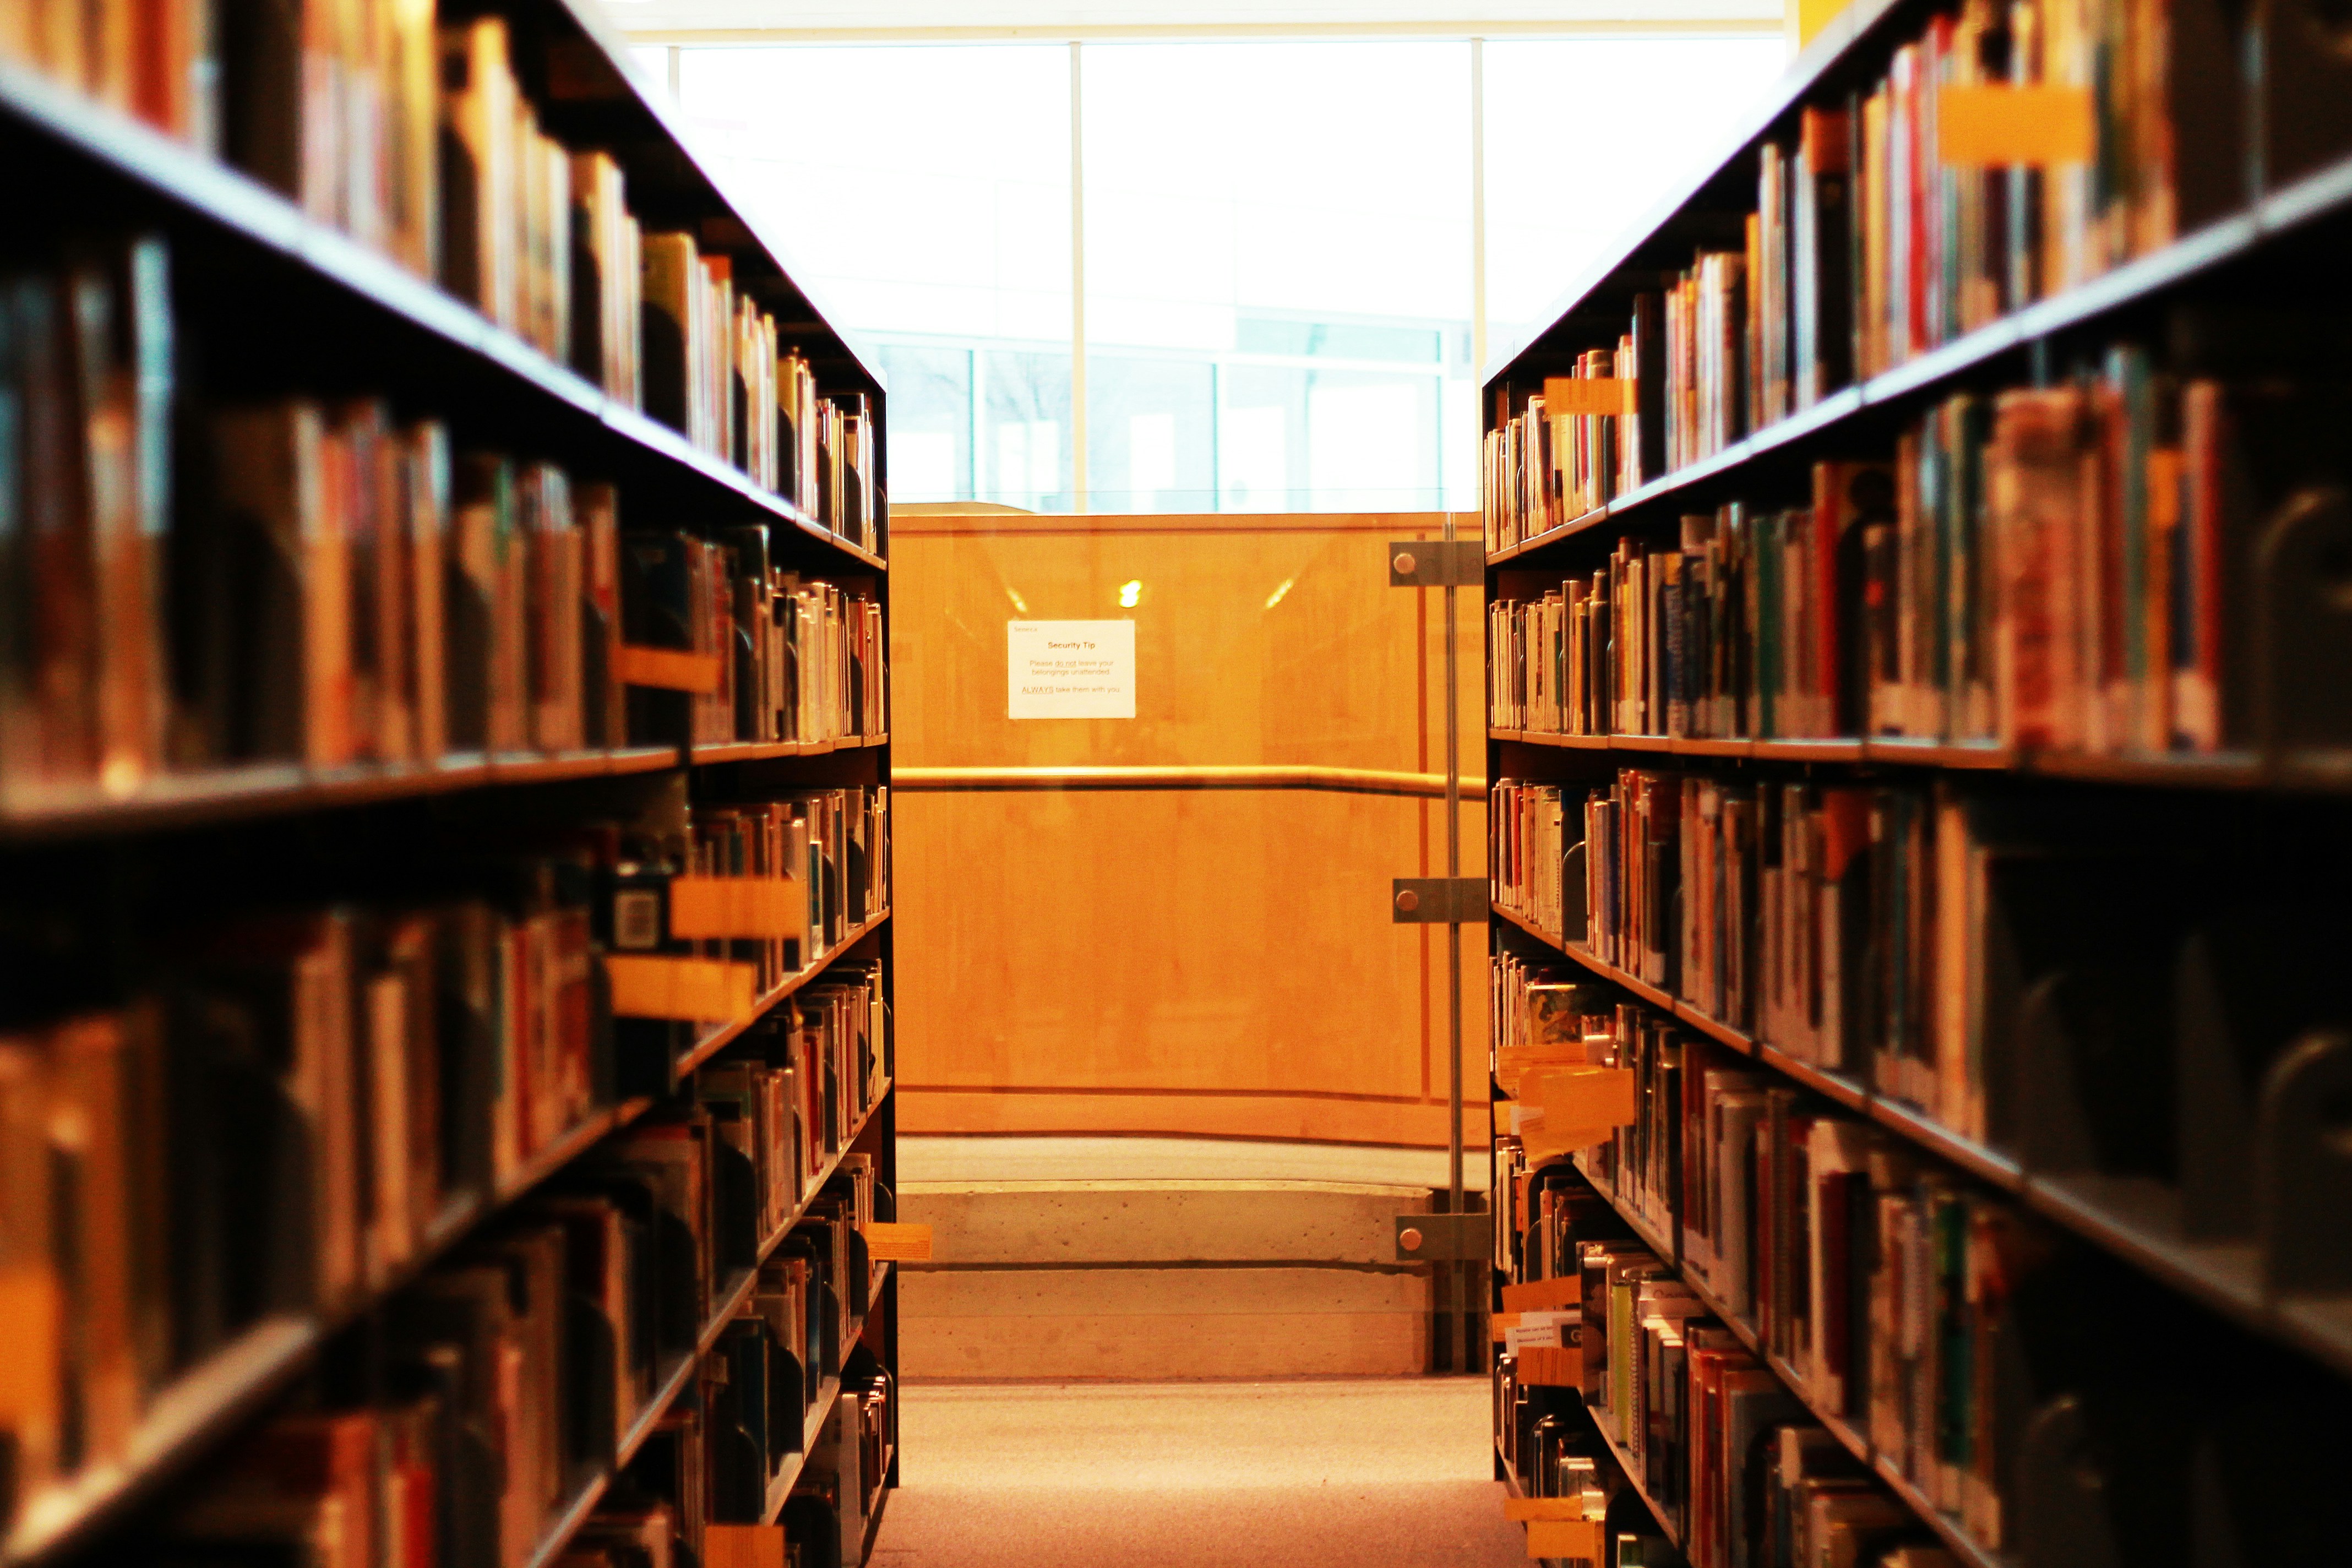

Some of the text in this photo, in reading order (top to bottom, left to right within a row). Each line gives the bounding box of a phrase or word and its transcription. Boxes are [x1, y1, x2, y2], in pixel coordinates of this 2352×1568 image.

[1048, 641, 1096, 650] Security Tip
[1022, 686, 1053, 694] ALWAYS
